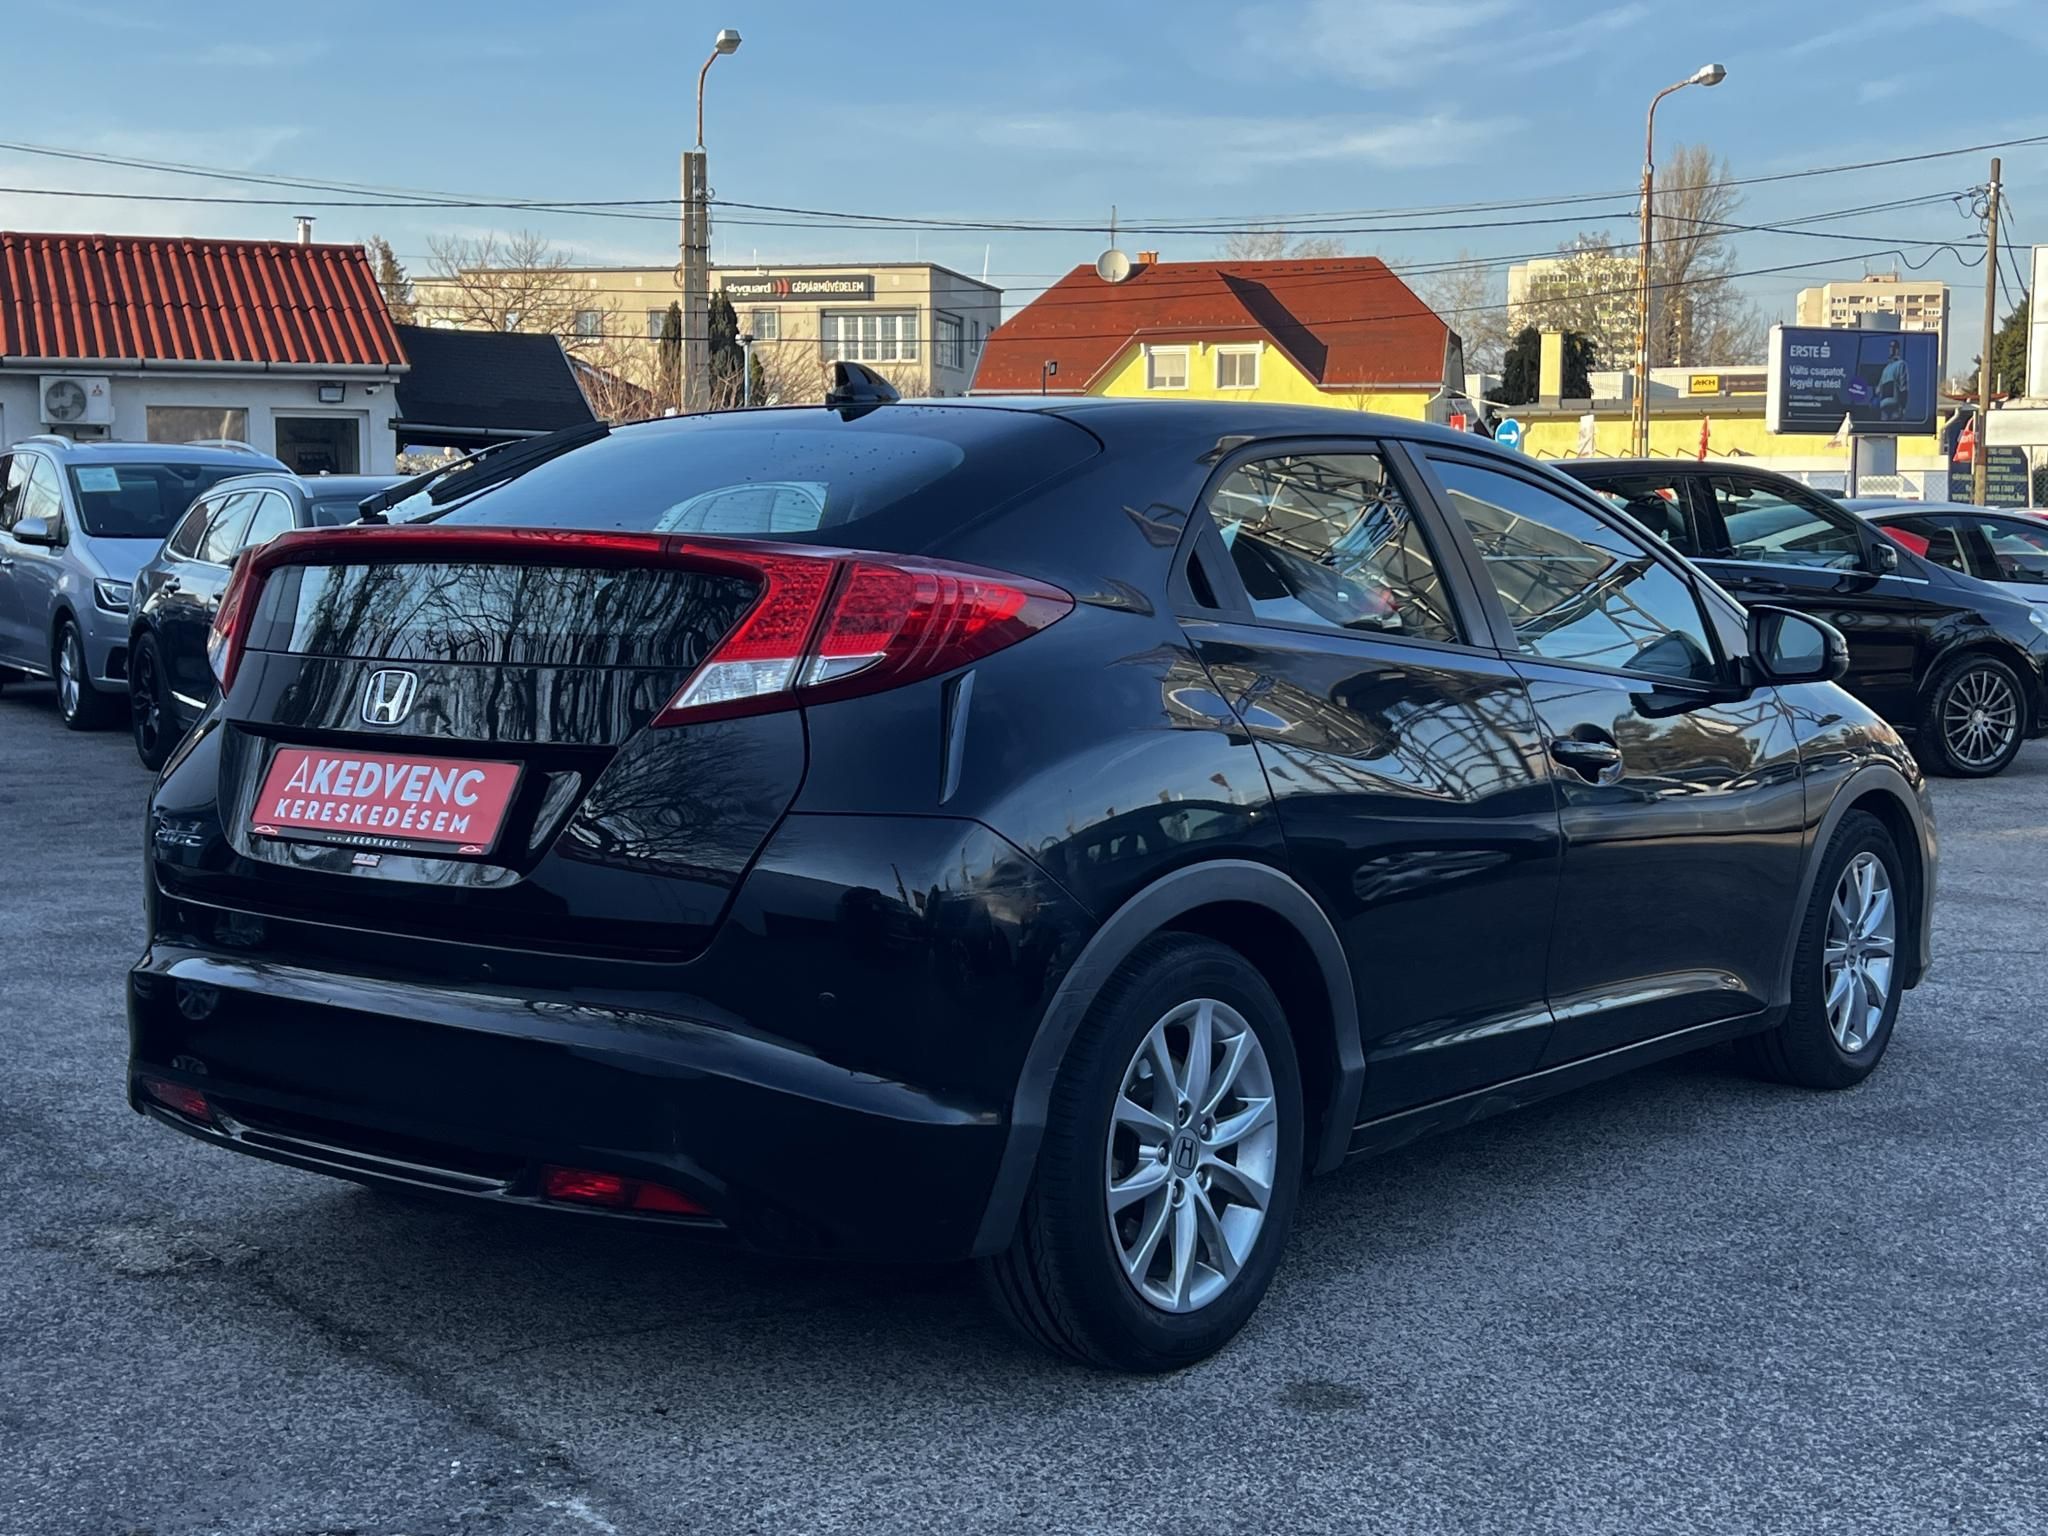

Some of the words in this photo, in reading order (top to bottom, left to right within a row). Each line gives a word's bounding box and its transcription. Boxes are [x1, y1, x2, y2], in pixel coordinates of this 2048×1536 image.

[726, 282, 772, 296] skyguard
[1789, 344, 1820, 358] ERSTE
[273, 797, 472, 834] KERESKEDÉSEM
